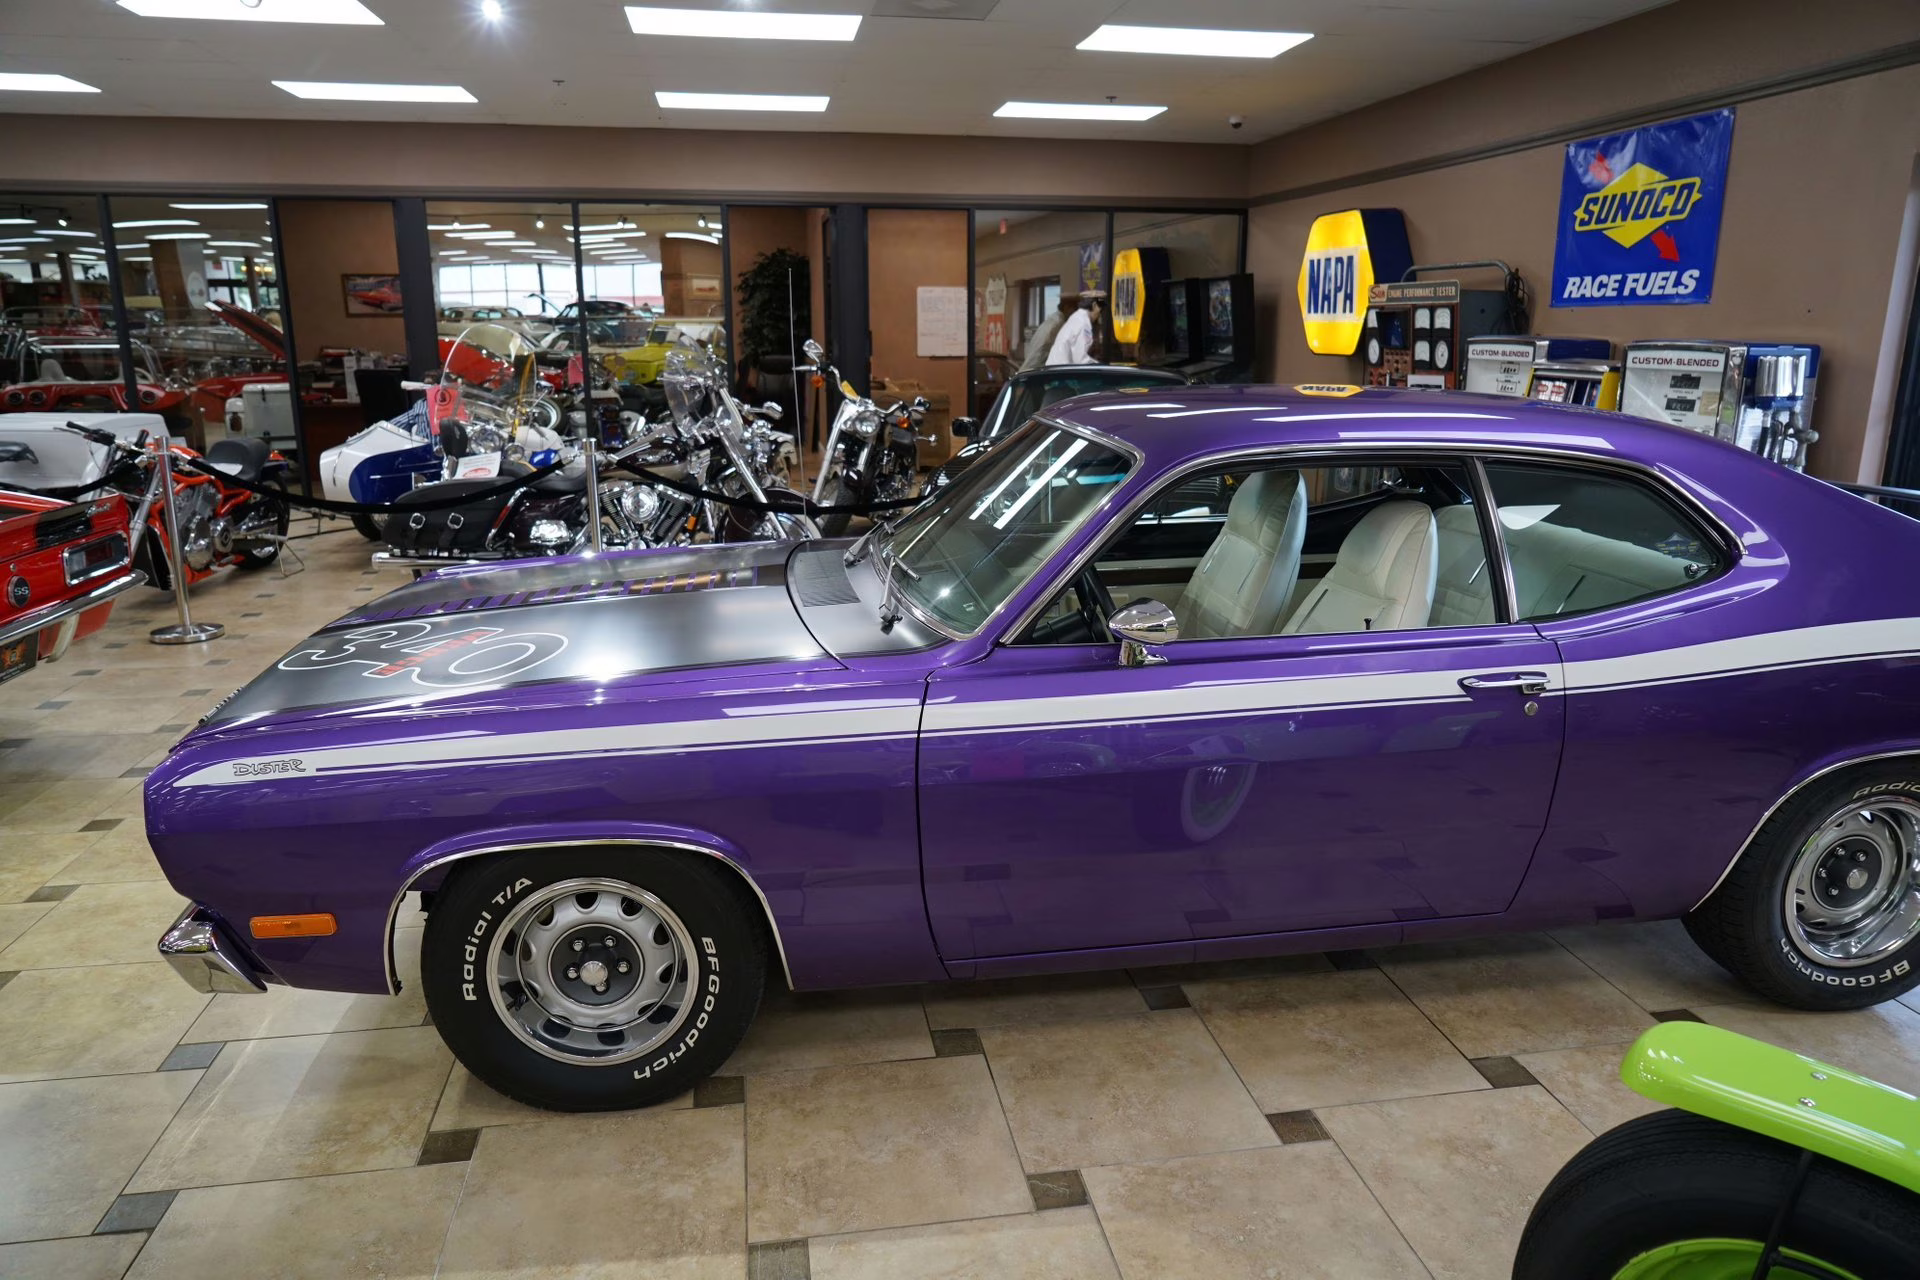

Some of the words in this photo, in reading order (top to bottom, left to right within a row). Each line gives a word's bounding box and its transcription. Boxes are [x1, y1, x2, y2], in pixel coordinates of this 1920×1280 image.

[1578, 182, 1697, 228] SUNOCO
[1307, 255, 1355, 315] NAPA
[1436, 285, 1456, 297] TESTER
[1563, 273, 1622, 299] RACE
[1623, 269, 1700, 297] FUELS
[14, 587, 29, 596] SS
[278, 622, 569, 689] 340
[232, 758, 307, 777] DUSTER
[463, 911, 493, 1001] Radial
[491, 877, 534, 907] T/A
[1779, 937, 1911, 988] BFGoodrich
[633, 935, 721, 1082] BFGoodrich
